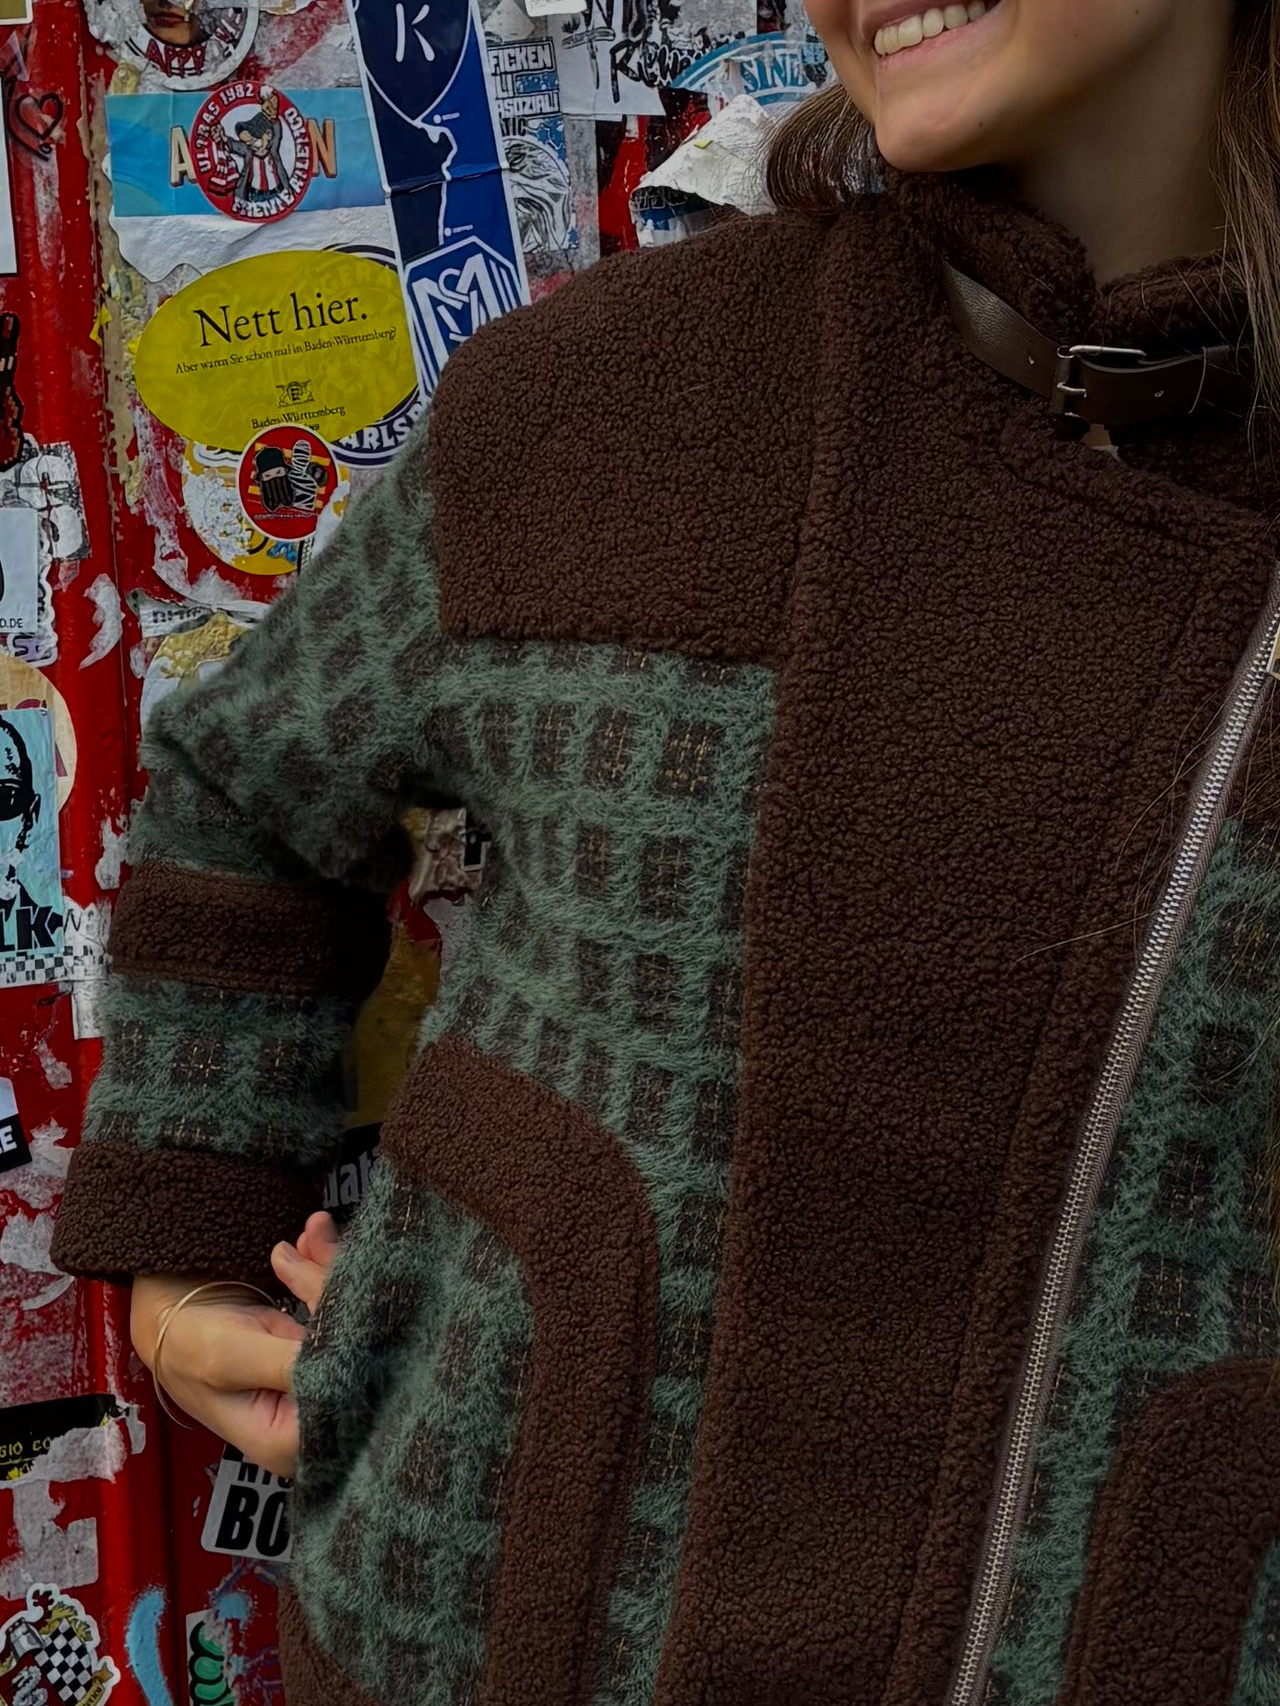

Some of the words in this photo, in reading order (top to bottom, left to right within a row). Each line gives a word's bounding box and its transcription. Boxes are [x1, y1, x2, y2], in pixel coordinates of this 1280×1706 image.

[192, 304, 285, 348] Nett
[288, 291, 368, 332] hier.
[174, 360, 199, 376] Aber
[244, 348, 272, 363] schon
